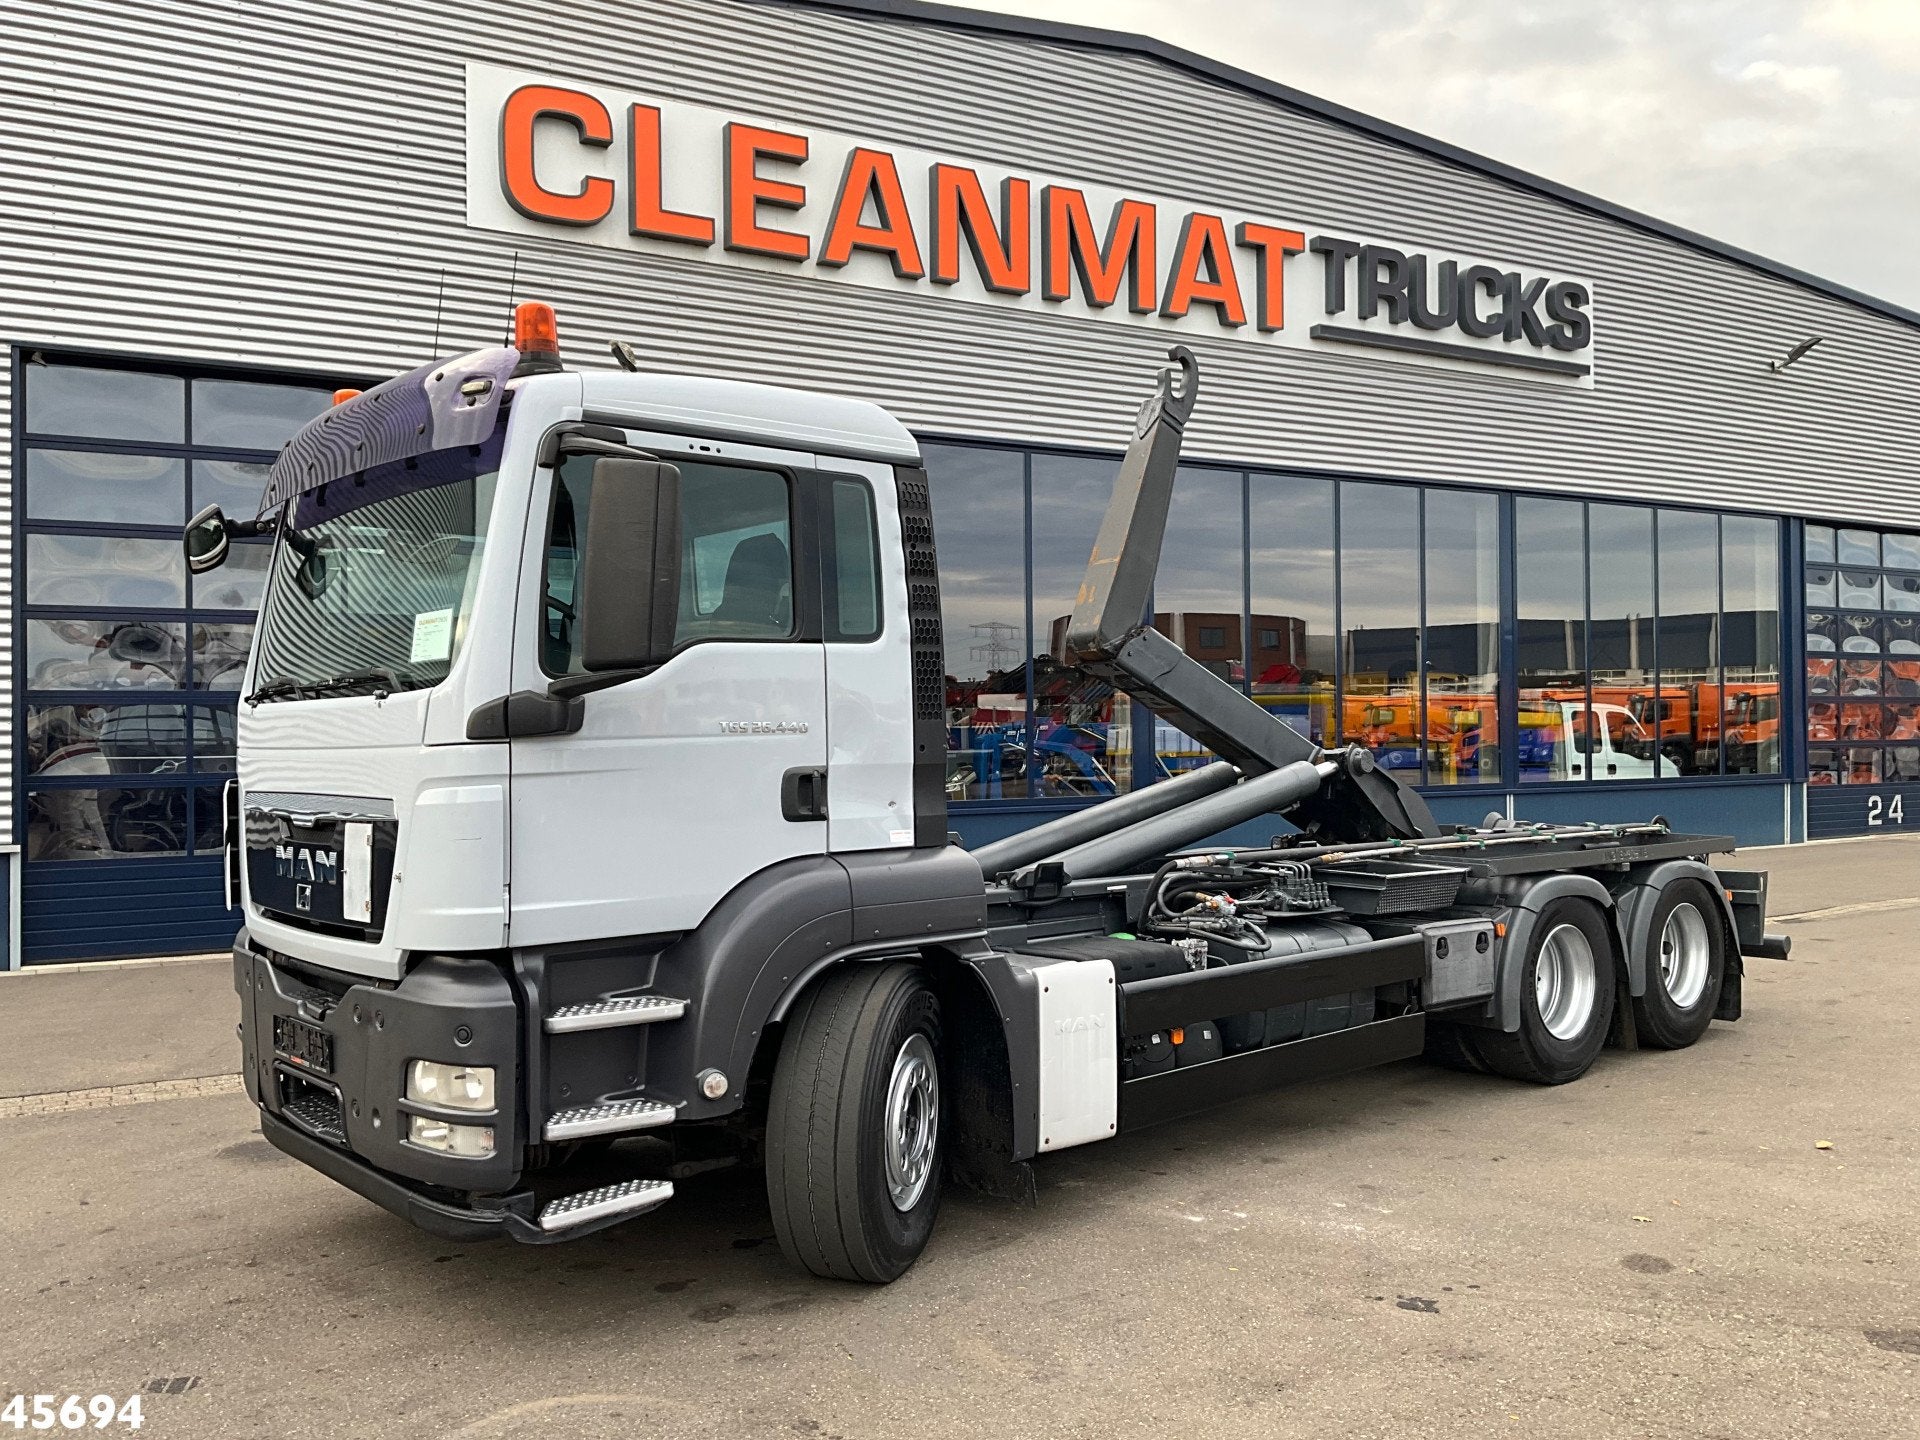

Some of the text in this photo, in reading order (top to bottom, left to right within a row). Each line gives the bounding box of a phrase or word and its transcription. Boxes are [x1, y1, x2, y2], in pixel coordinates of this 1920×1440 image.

[500, 84, 1591, 351] CLEANMAT TRUCKS
[719, 721, 808, 733] TGS 26.440
[1868, 794, 1904, 826] 24
[275, 845, 337, 885] MAN
